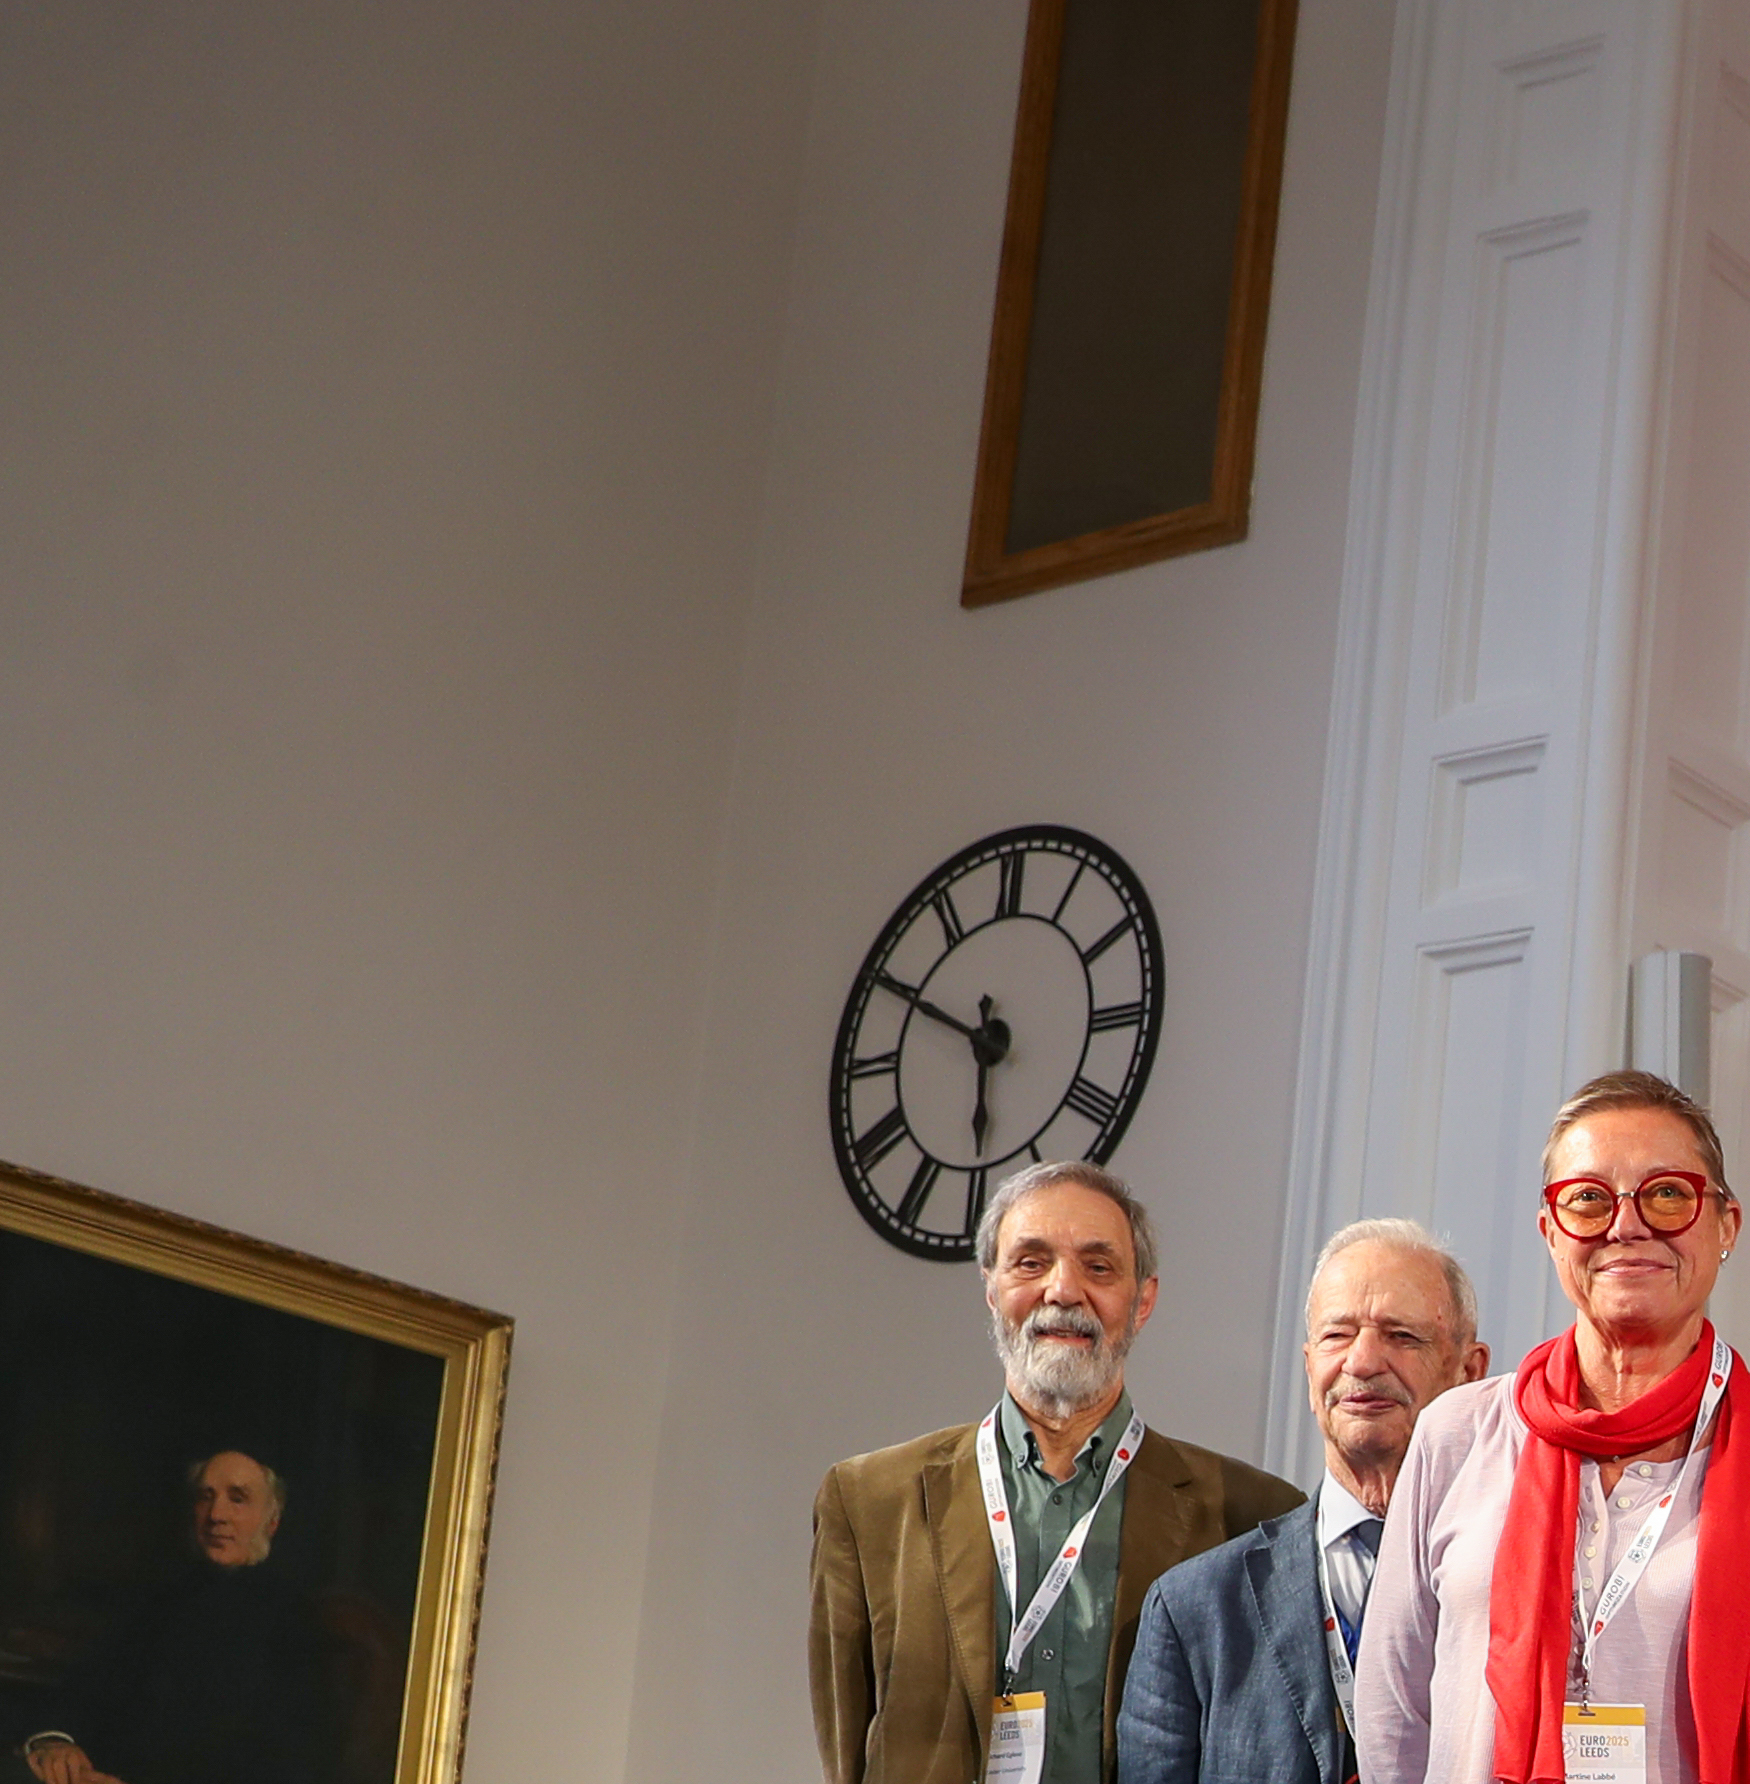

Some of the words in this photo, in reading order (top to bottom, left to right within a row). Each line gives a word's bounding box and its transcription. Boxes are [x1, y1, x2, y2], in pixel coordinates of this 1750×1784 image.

[1600, 1575, 1625, 1615] GUROBI
[1579, 1735, 1630, 1747] EURO2025
[1579, 1747, 1610, 1758] LEEDS
